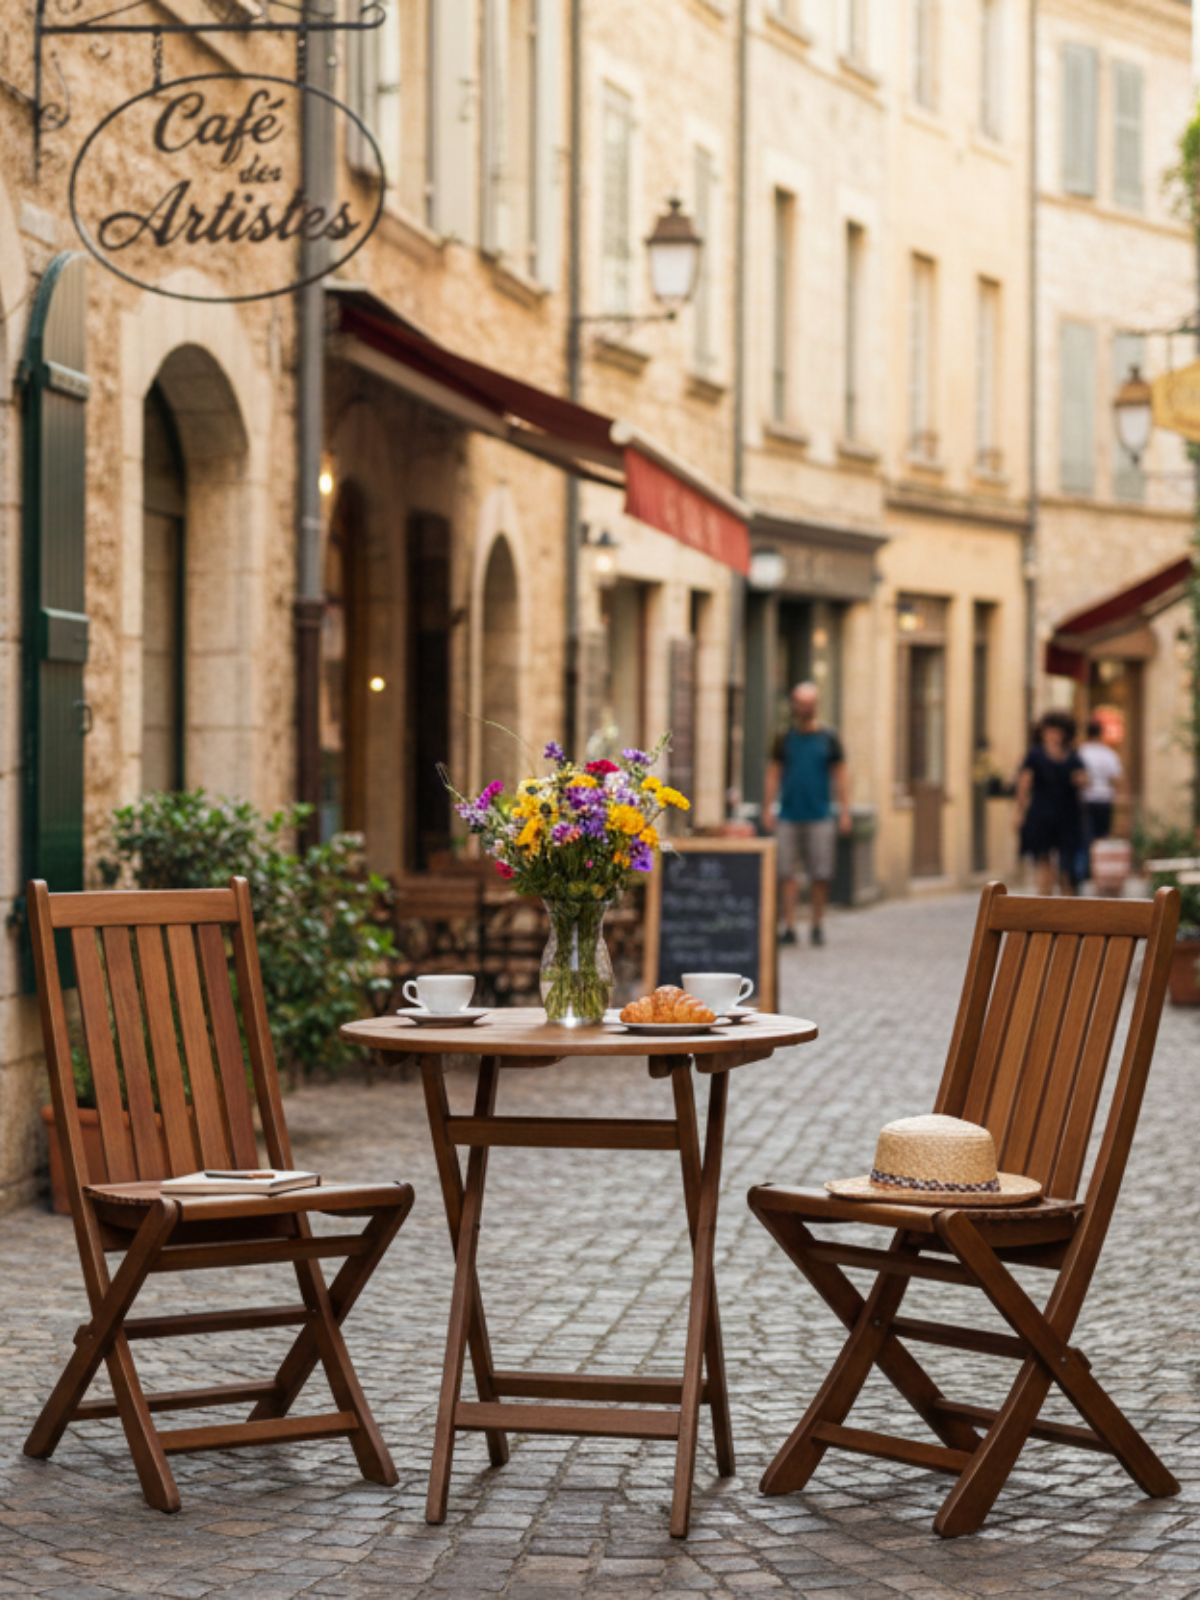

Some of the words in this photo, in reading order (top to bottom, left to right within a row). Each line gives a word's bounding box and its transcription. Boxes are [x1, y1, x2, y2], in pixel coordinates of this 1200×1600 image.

[153, 89, 284, 171] Café
[238, 155, 282, 184] des
[98, 180, 360, 250] Artistes
